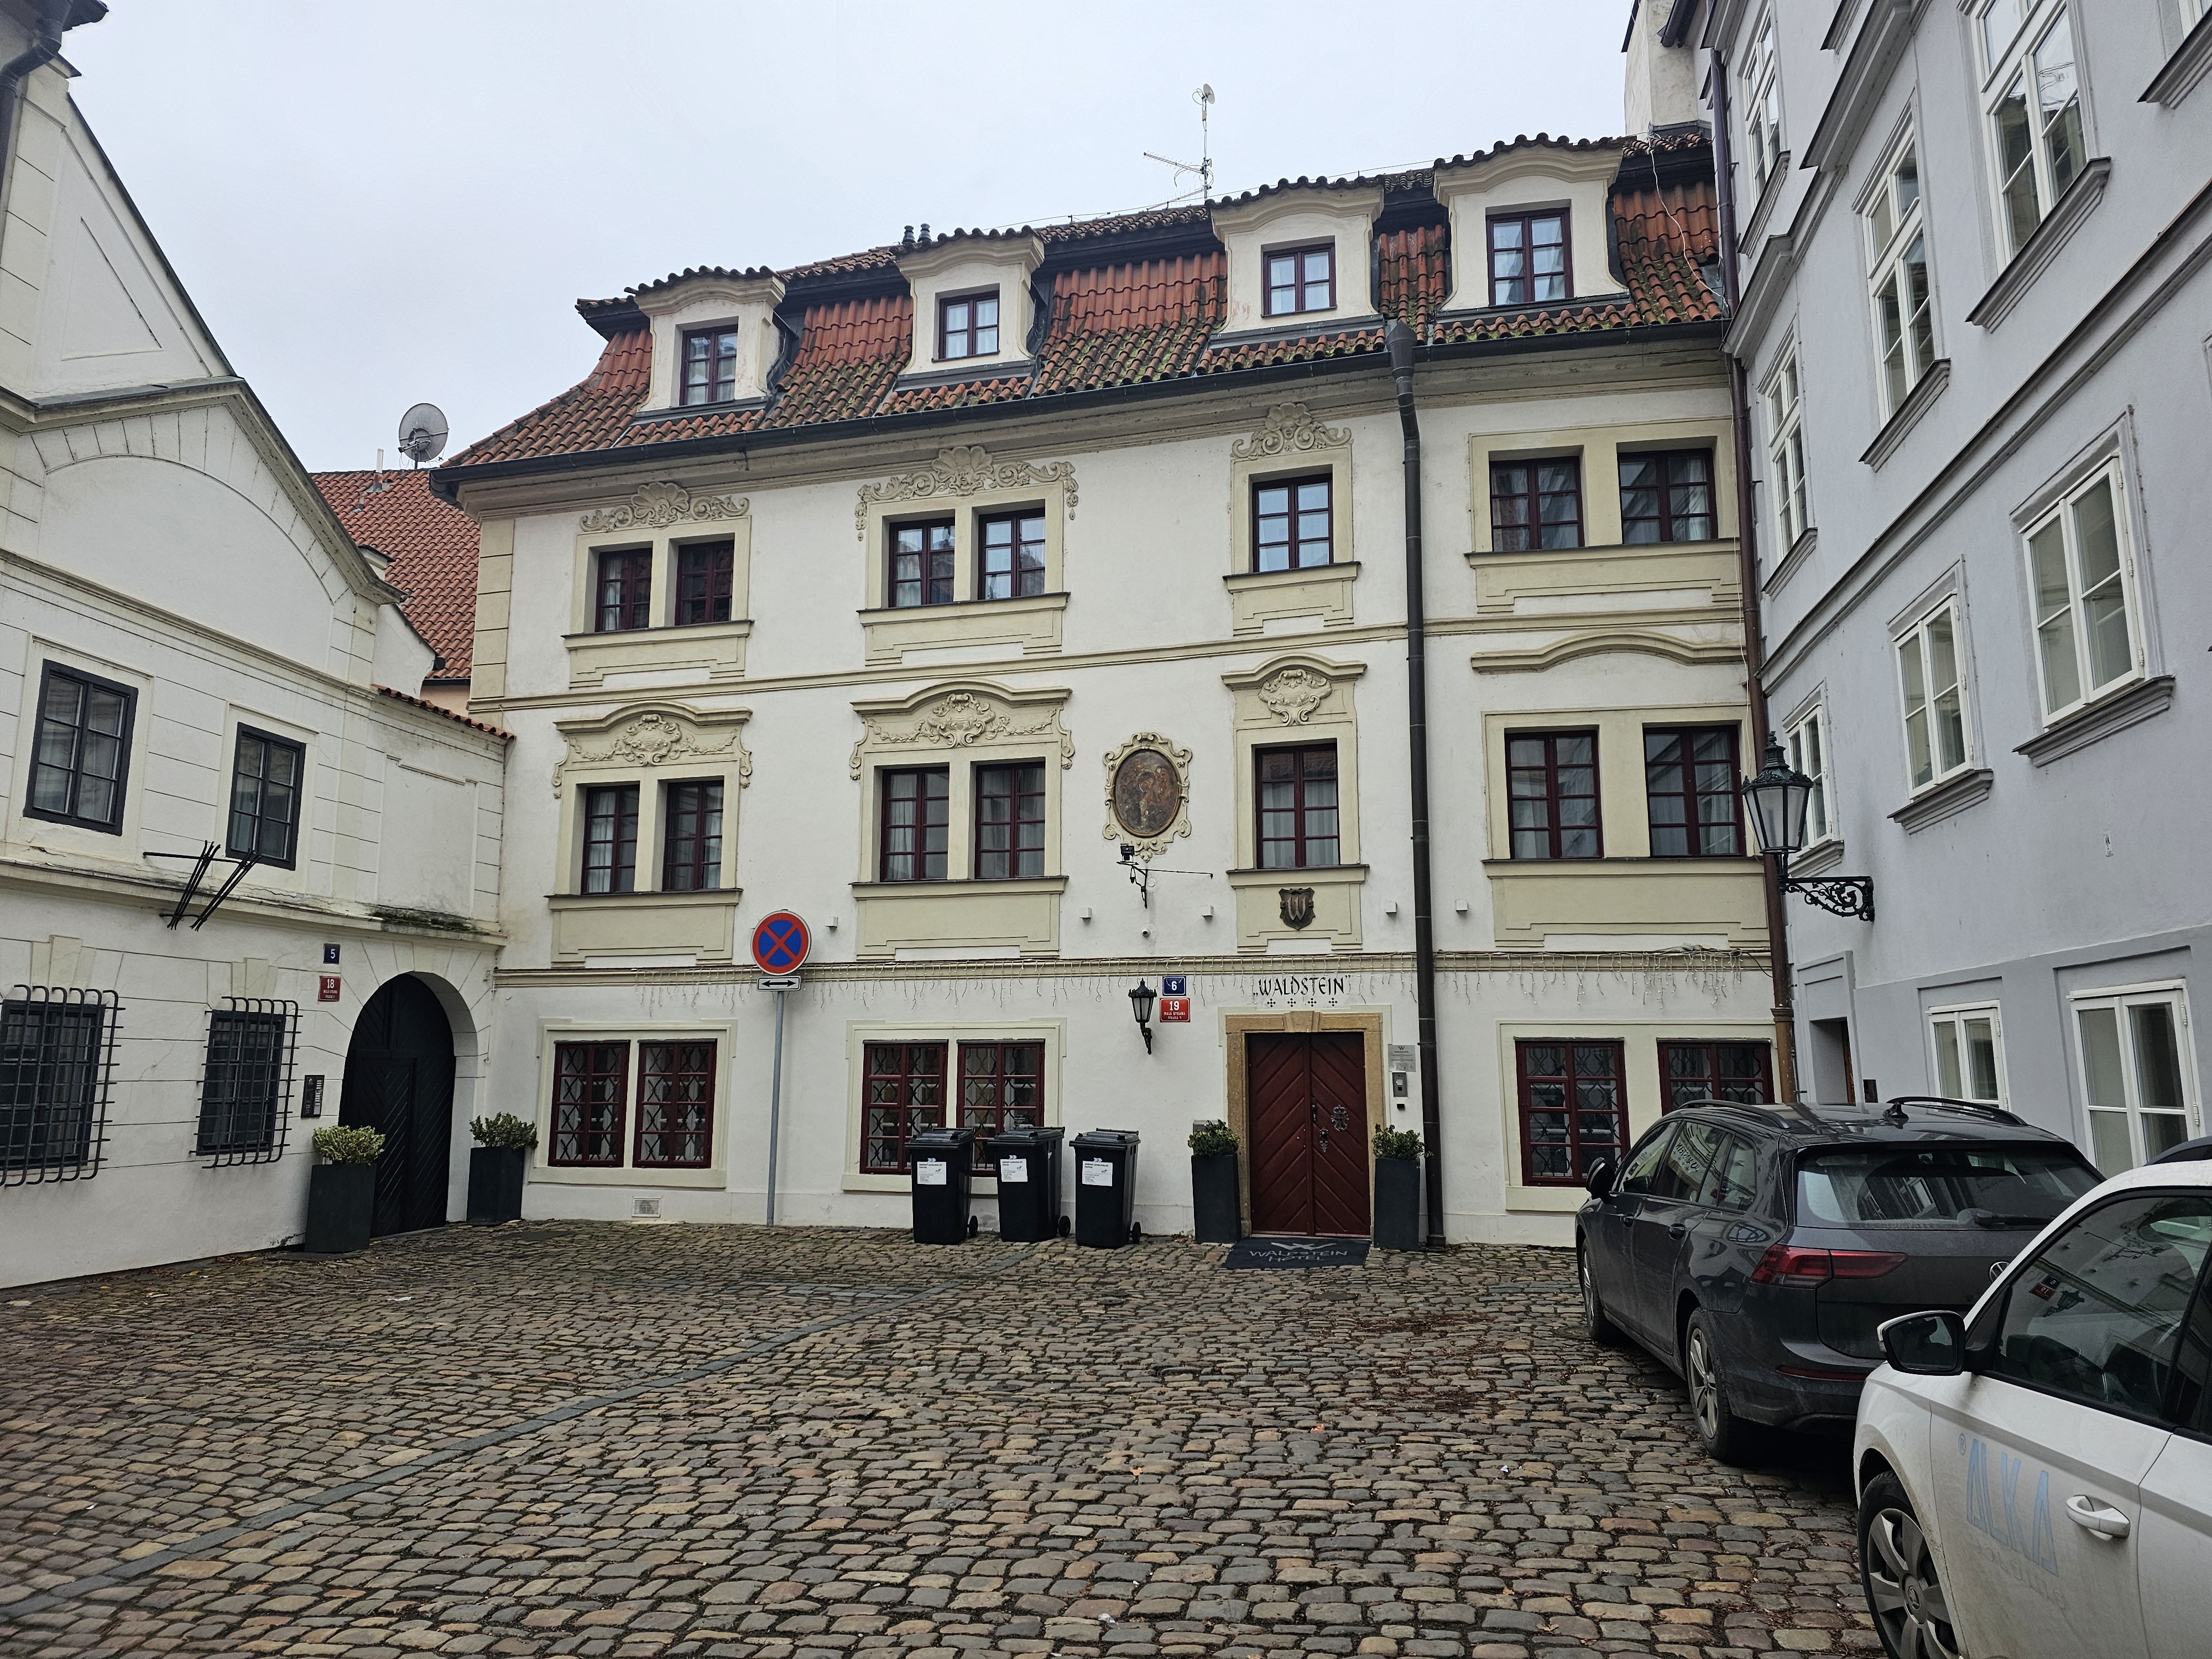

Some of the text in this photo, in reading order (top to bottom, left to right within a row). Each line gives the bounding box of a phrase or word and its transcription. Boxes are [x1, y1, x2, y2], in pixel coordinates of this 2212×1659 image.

[330, 948, 336, 959] 5
[327, 978, 335, 989] 18
[1171, 980, 1177, 991] 6
[1169, 1000, 1180, 1011] 19
[1966, 1438, 2059, 1577] ALKA
